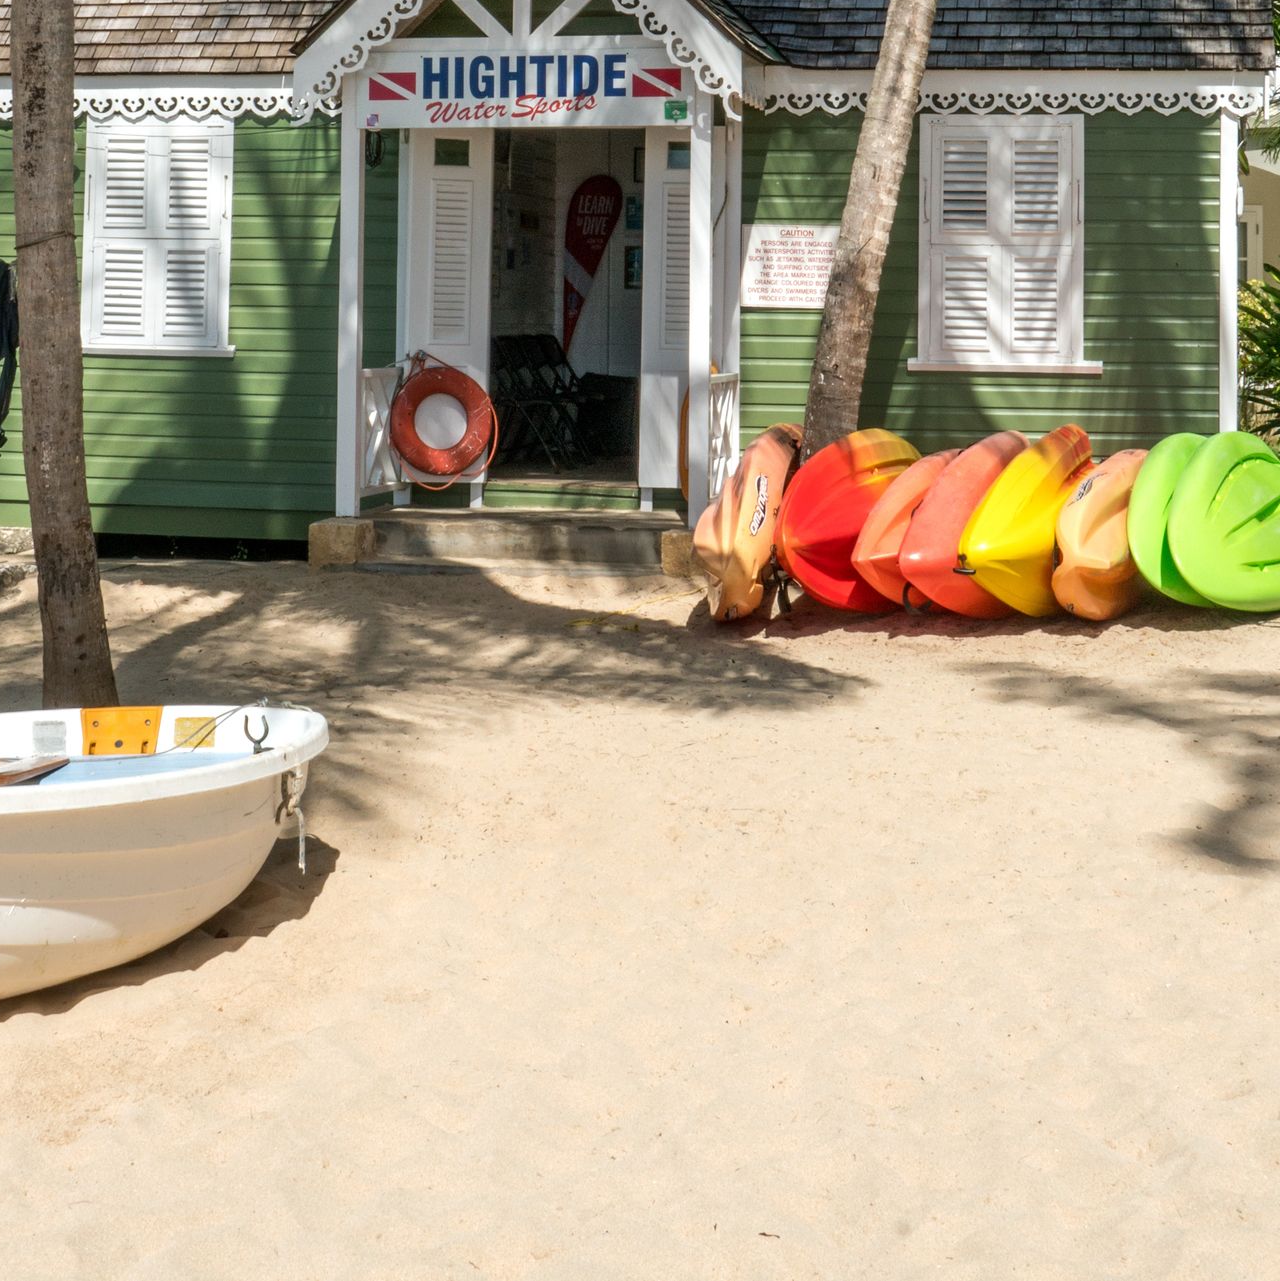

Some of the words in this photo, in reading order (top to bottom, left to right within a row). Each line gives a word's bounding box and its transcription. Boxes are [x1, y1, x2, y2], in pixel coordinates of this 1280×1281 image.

[423, 54, 626, 99] HIGHTIDE
[425, 101, 507, 123] Water
[511, 93, 597, 120] Sports
[578, 195, 615, 215] LEARN
[583, 215, 608, 235] DIVE
[780, 229, 814, 237] CAUTION
